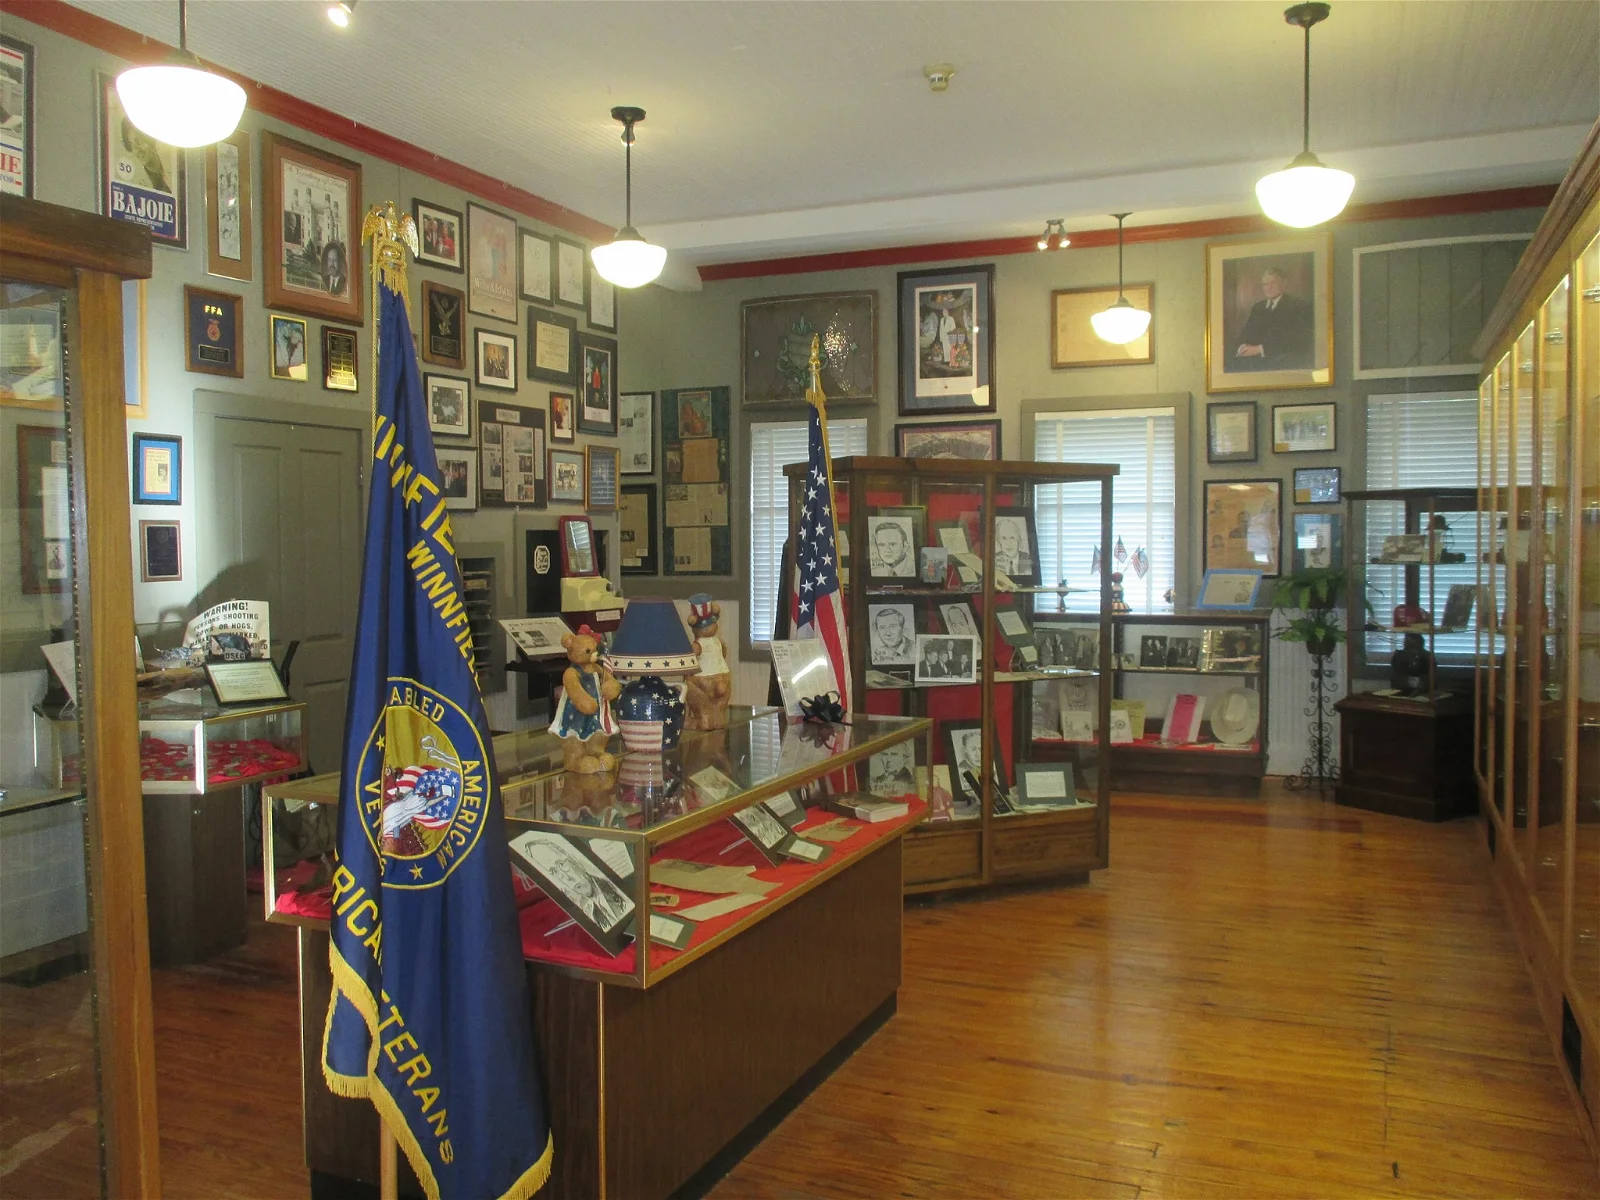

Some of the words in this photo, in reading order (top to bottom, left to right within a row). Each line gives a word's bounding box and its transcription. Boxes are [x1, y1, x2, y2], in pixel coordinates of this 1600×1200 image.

[120, 163, 131, 173] 50
[113, 191, 173, 223] BAJOIE
[204, 305, 223, 316] FFA
[203, 602, 249, 619] WARNING!
[436, 760, 483, 870] AMERICAN
